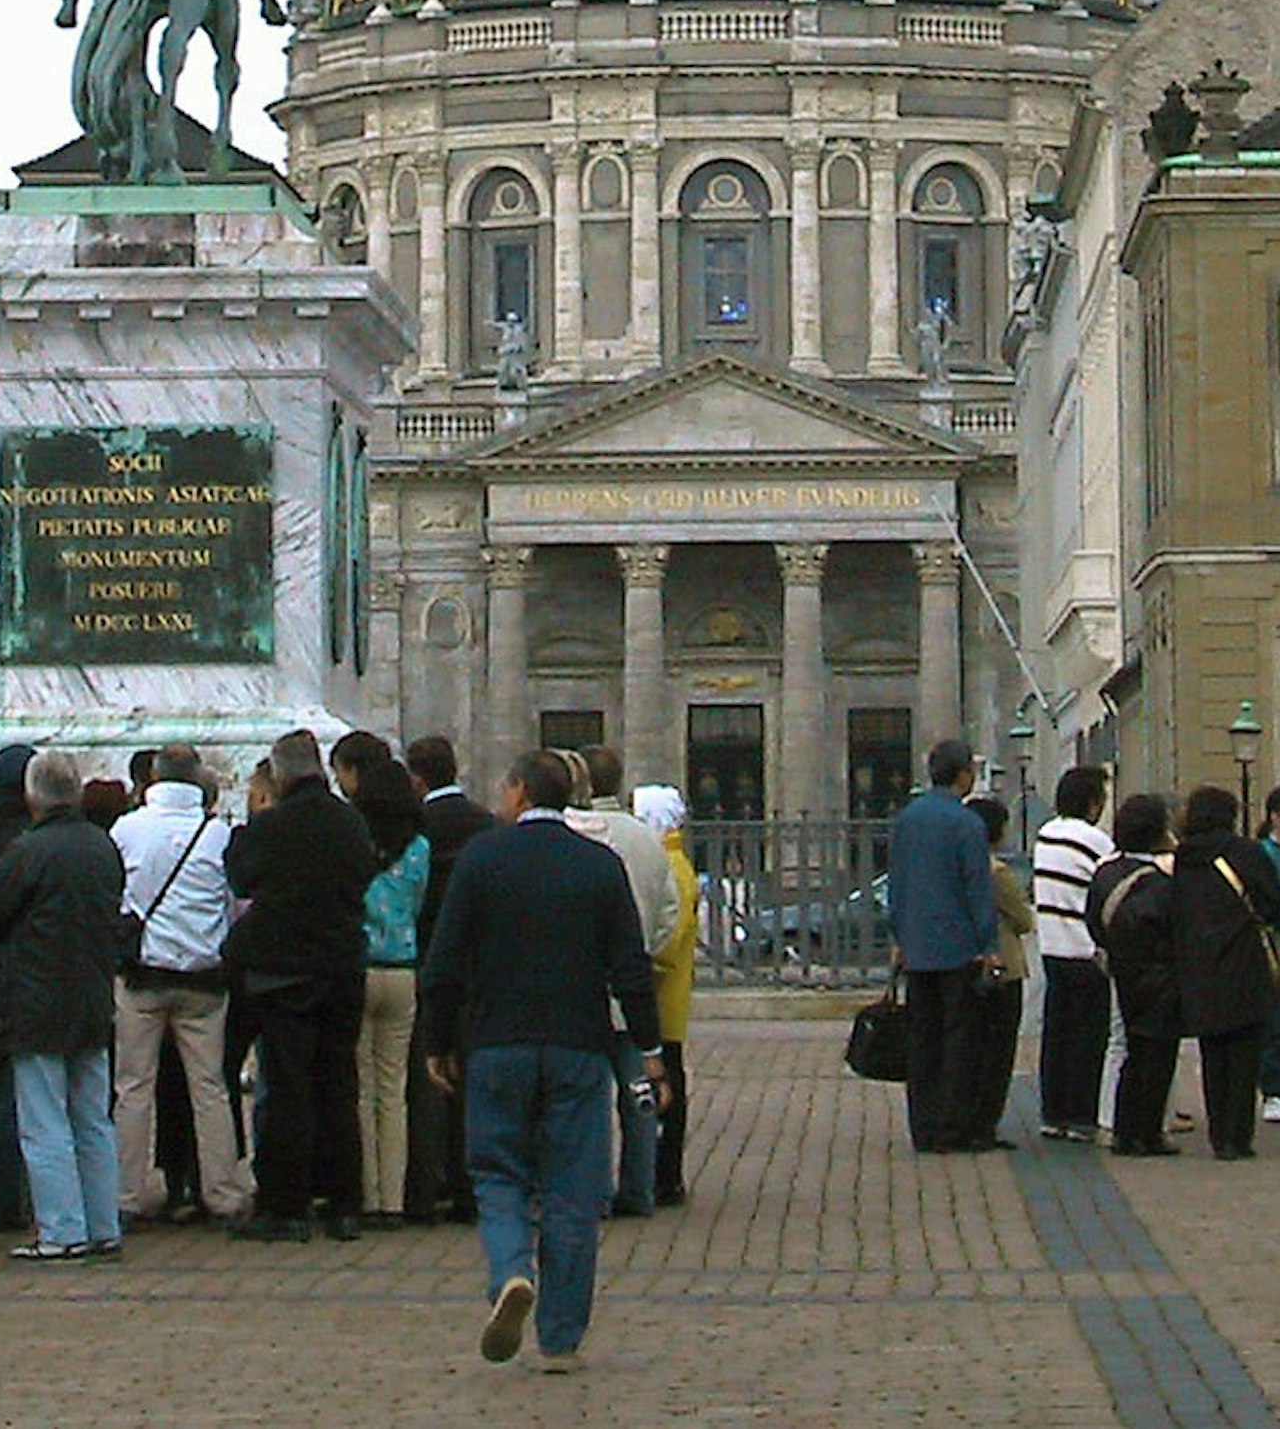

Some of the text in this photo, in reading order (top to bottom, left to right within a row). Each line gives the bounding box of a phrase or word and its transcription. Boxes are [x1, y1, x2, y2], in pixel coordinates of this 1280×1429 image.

[107, 454, 163, 473] SOCII
[0, 485, 273, 506] NEGOTIATIONIS ASIATICAE
[38, 517, 232, 537] PIETATIS PUBLICAE
[60, 549, 211, 568] MONUMENTUM
[88, 581, 183, 600] POSUERE
